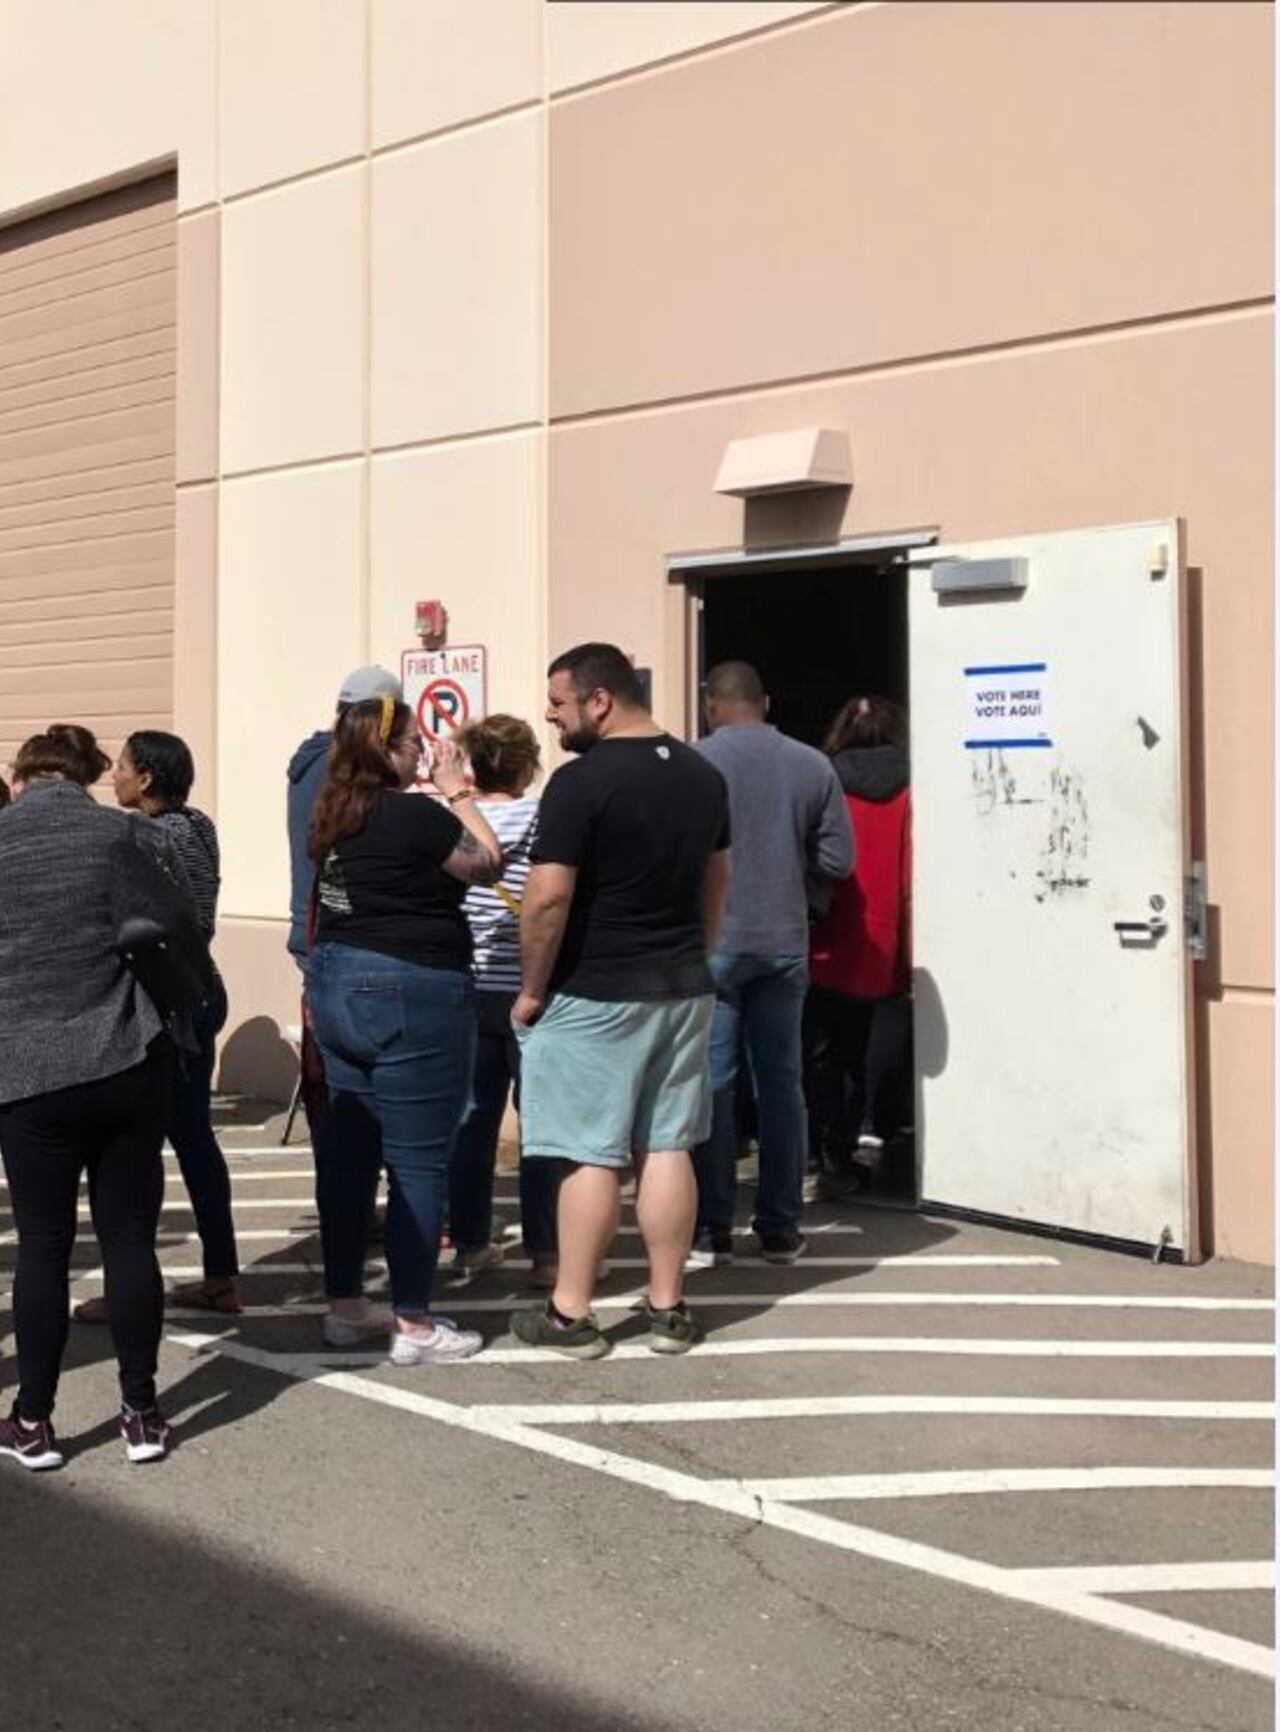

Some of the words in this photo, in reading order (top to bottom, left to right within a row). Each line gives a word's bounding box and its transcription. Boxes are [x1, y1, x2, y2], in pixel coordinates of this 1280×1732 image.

[407, 658, 436, 675] FIRE
[442, 654, 480, 675] LANE
[976, 690, 1006, 702] VOTE
[1010, 689, 1041, 701] HERE
[975, 706, 1006, 717] VOTE
